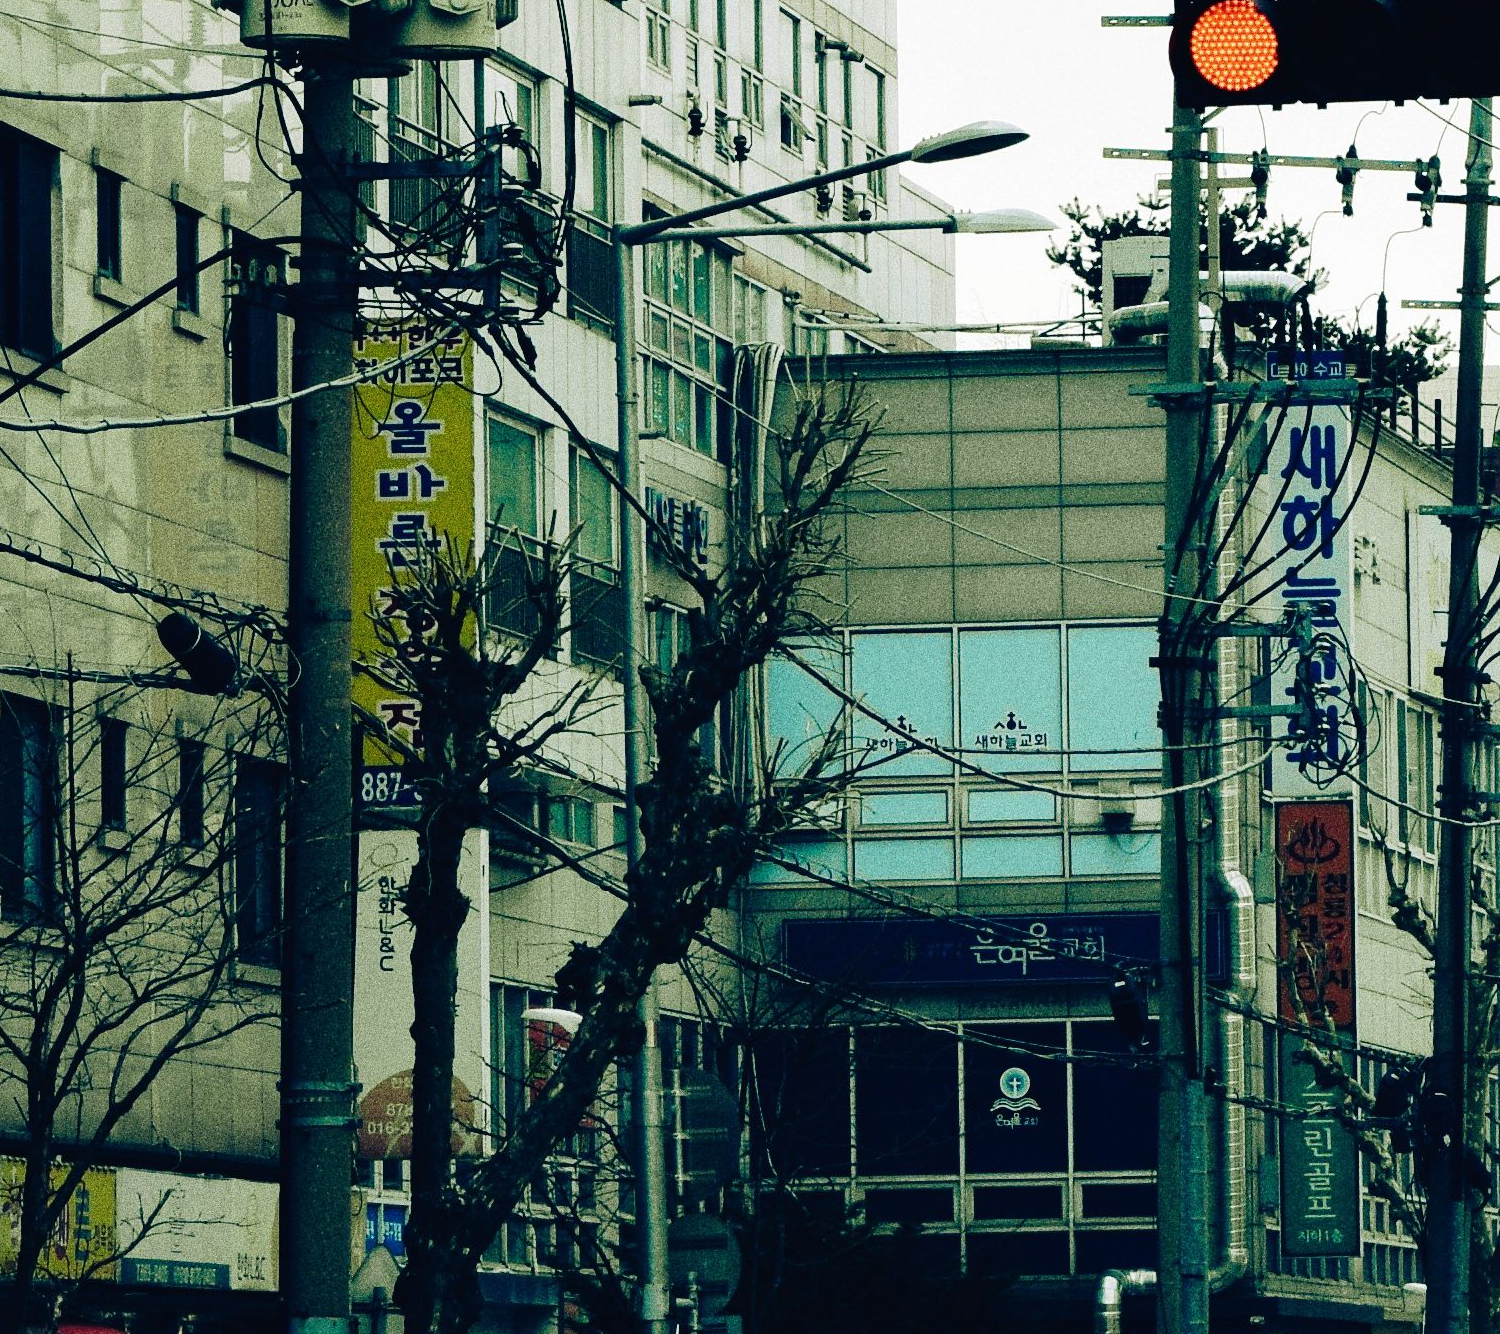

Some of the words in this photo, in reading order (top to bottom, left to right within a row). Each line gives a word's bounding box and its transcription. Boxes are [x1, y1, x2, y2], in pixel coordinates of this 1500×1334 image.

[975, 733, 1047, 749] 새하늘교회
[970, 923, 1056, 975] 은여울
[1061, 935, 1105, 962] 교회
